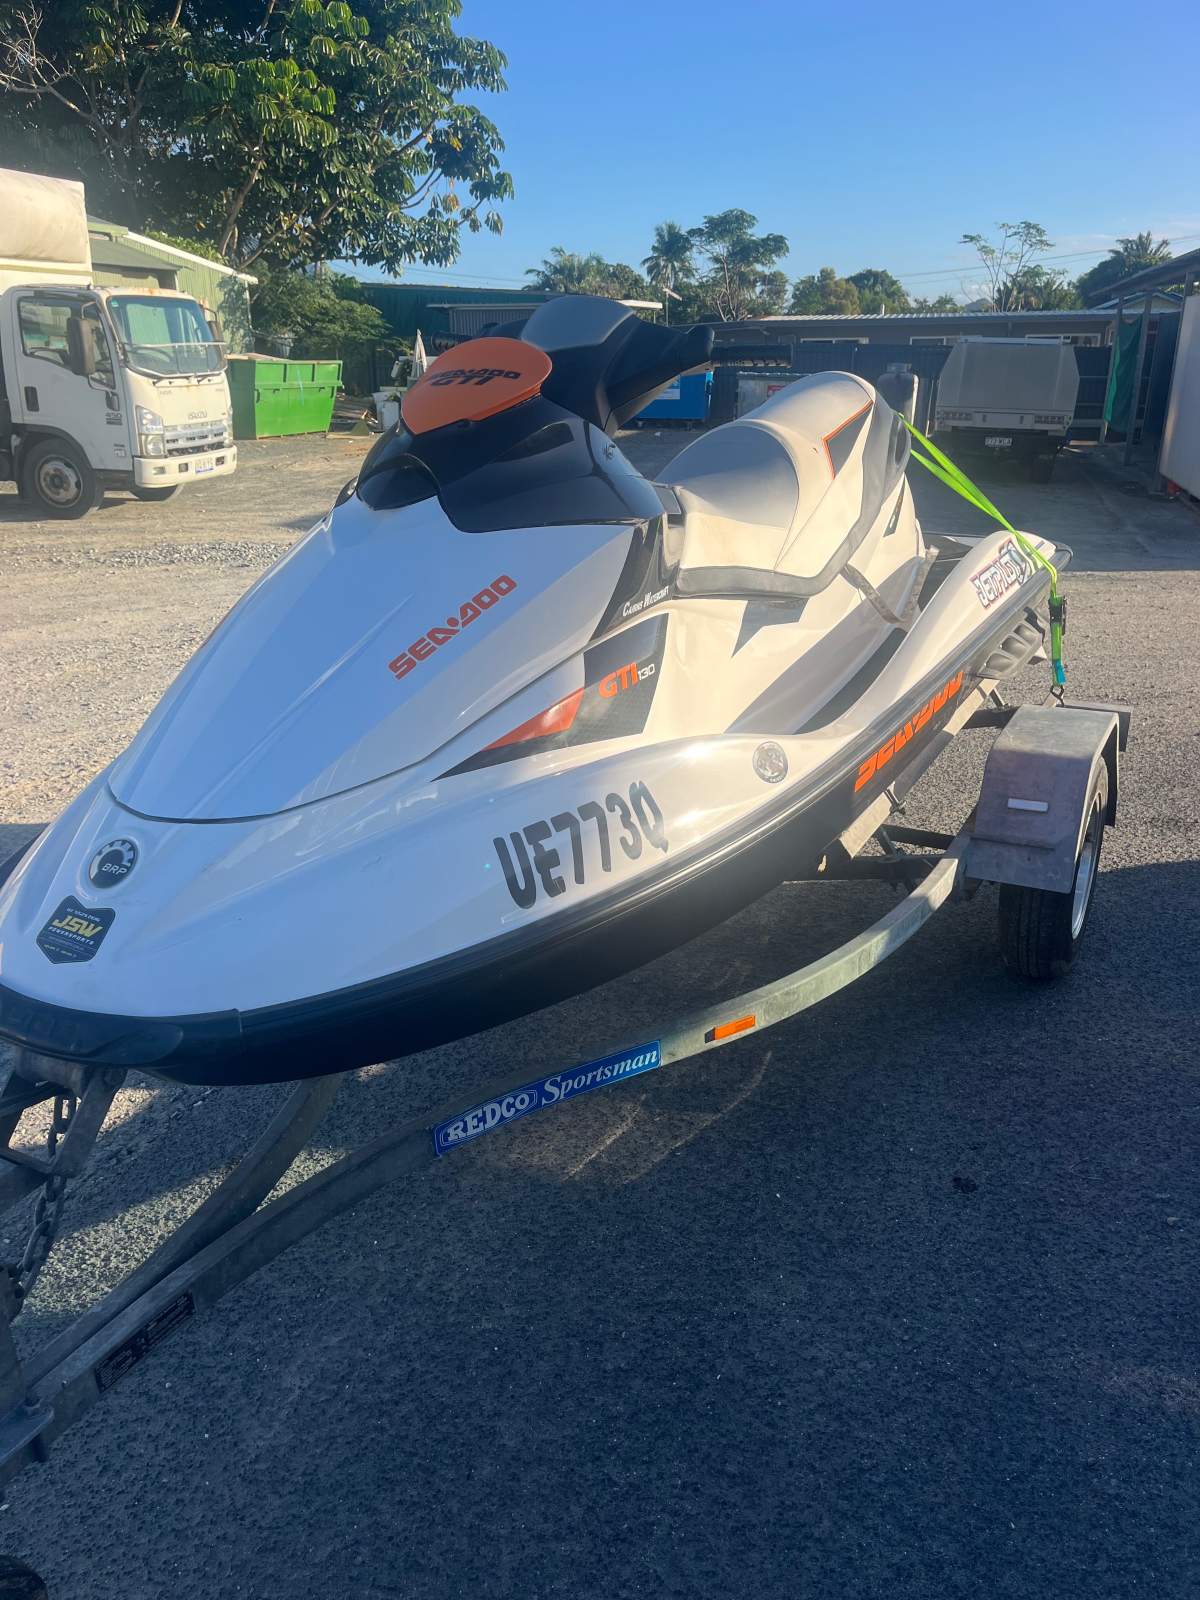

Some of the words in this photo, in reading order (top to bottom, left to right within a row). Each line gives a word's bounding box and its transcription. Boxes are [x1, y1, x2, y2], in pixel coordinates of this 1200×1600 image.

[598, 662, 640, 699] GTI
[493, 780, 669, 910] UE773Q
[102, 863, 128, 875] BRP
[52, 915, 104, 938] JSW
[447, 1092, 530, 1141] REDCO
[541, 1050, 658, 1105] Sportsman
